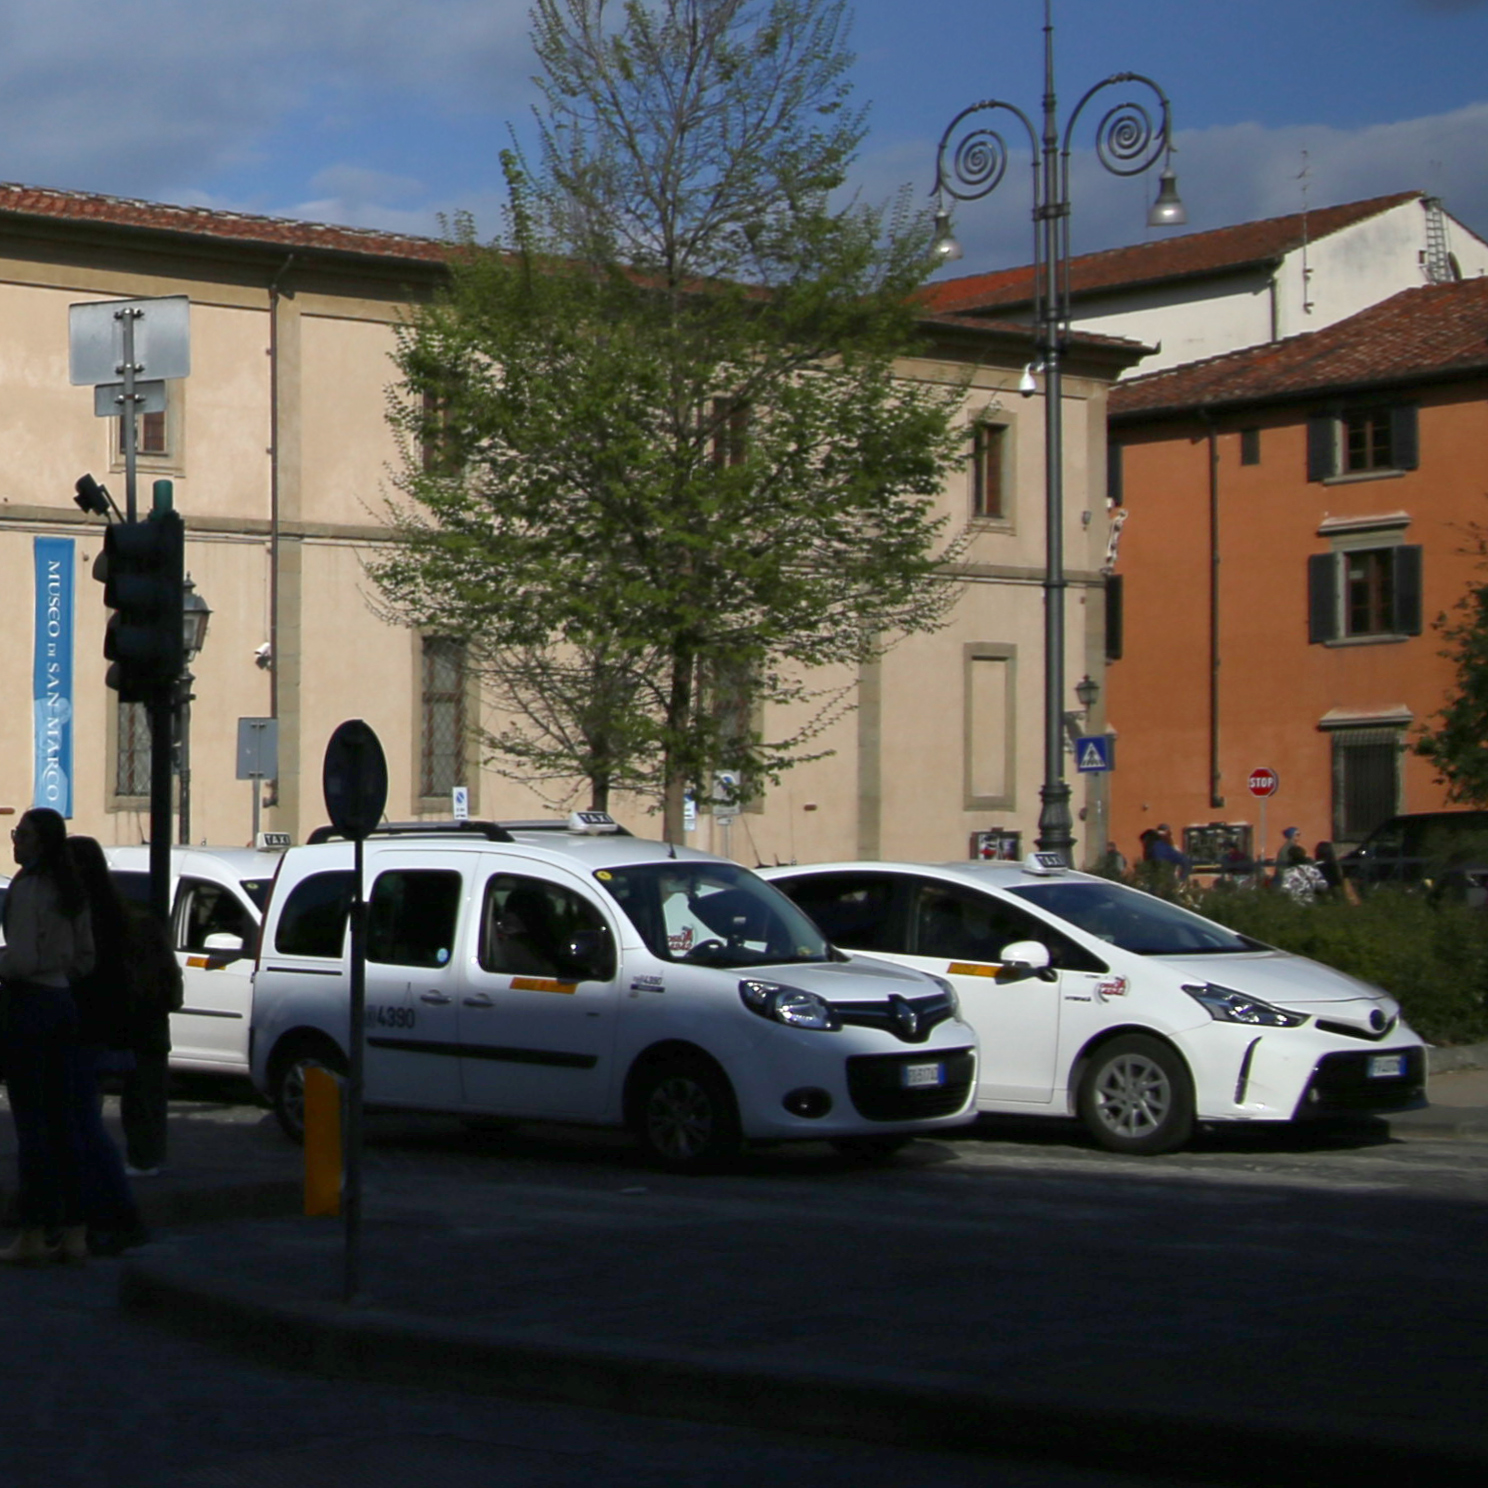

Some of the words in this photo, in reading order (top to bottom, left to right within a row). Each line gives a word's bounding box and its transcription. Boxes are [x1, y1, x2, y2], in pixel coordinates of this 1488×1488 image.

[47, 560, 61, 638] MUSEO
[46, 662, 60, 707] SAN
[42, 717, 60, 801] MARCO
[1249, 777, 1274, 788] STOP
[579, 813, 613, 823] TAXI
[266, 835, 290, 844] TAXI
[377, 1005, 415, 1029] 4390
